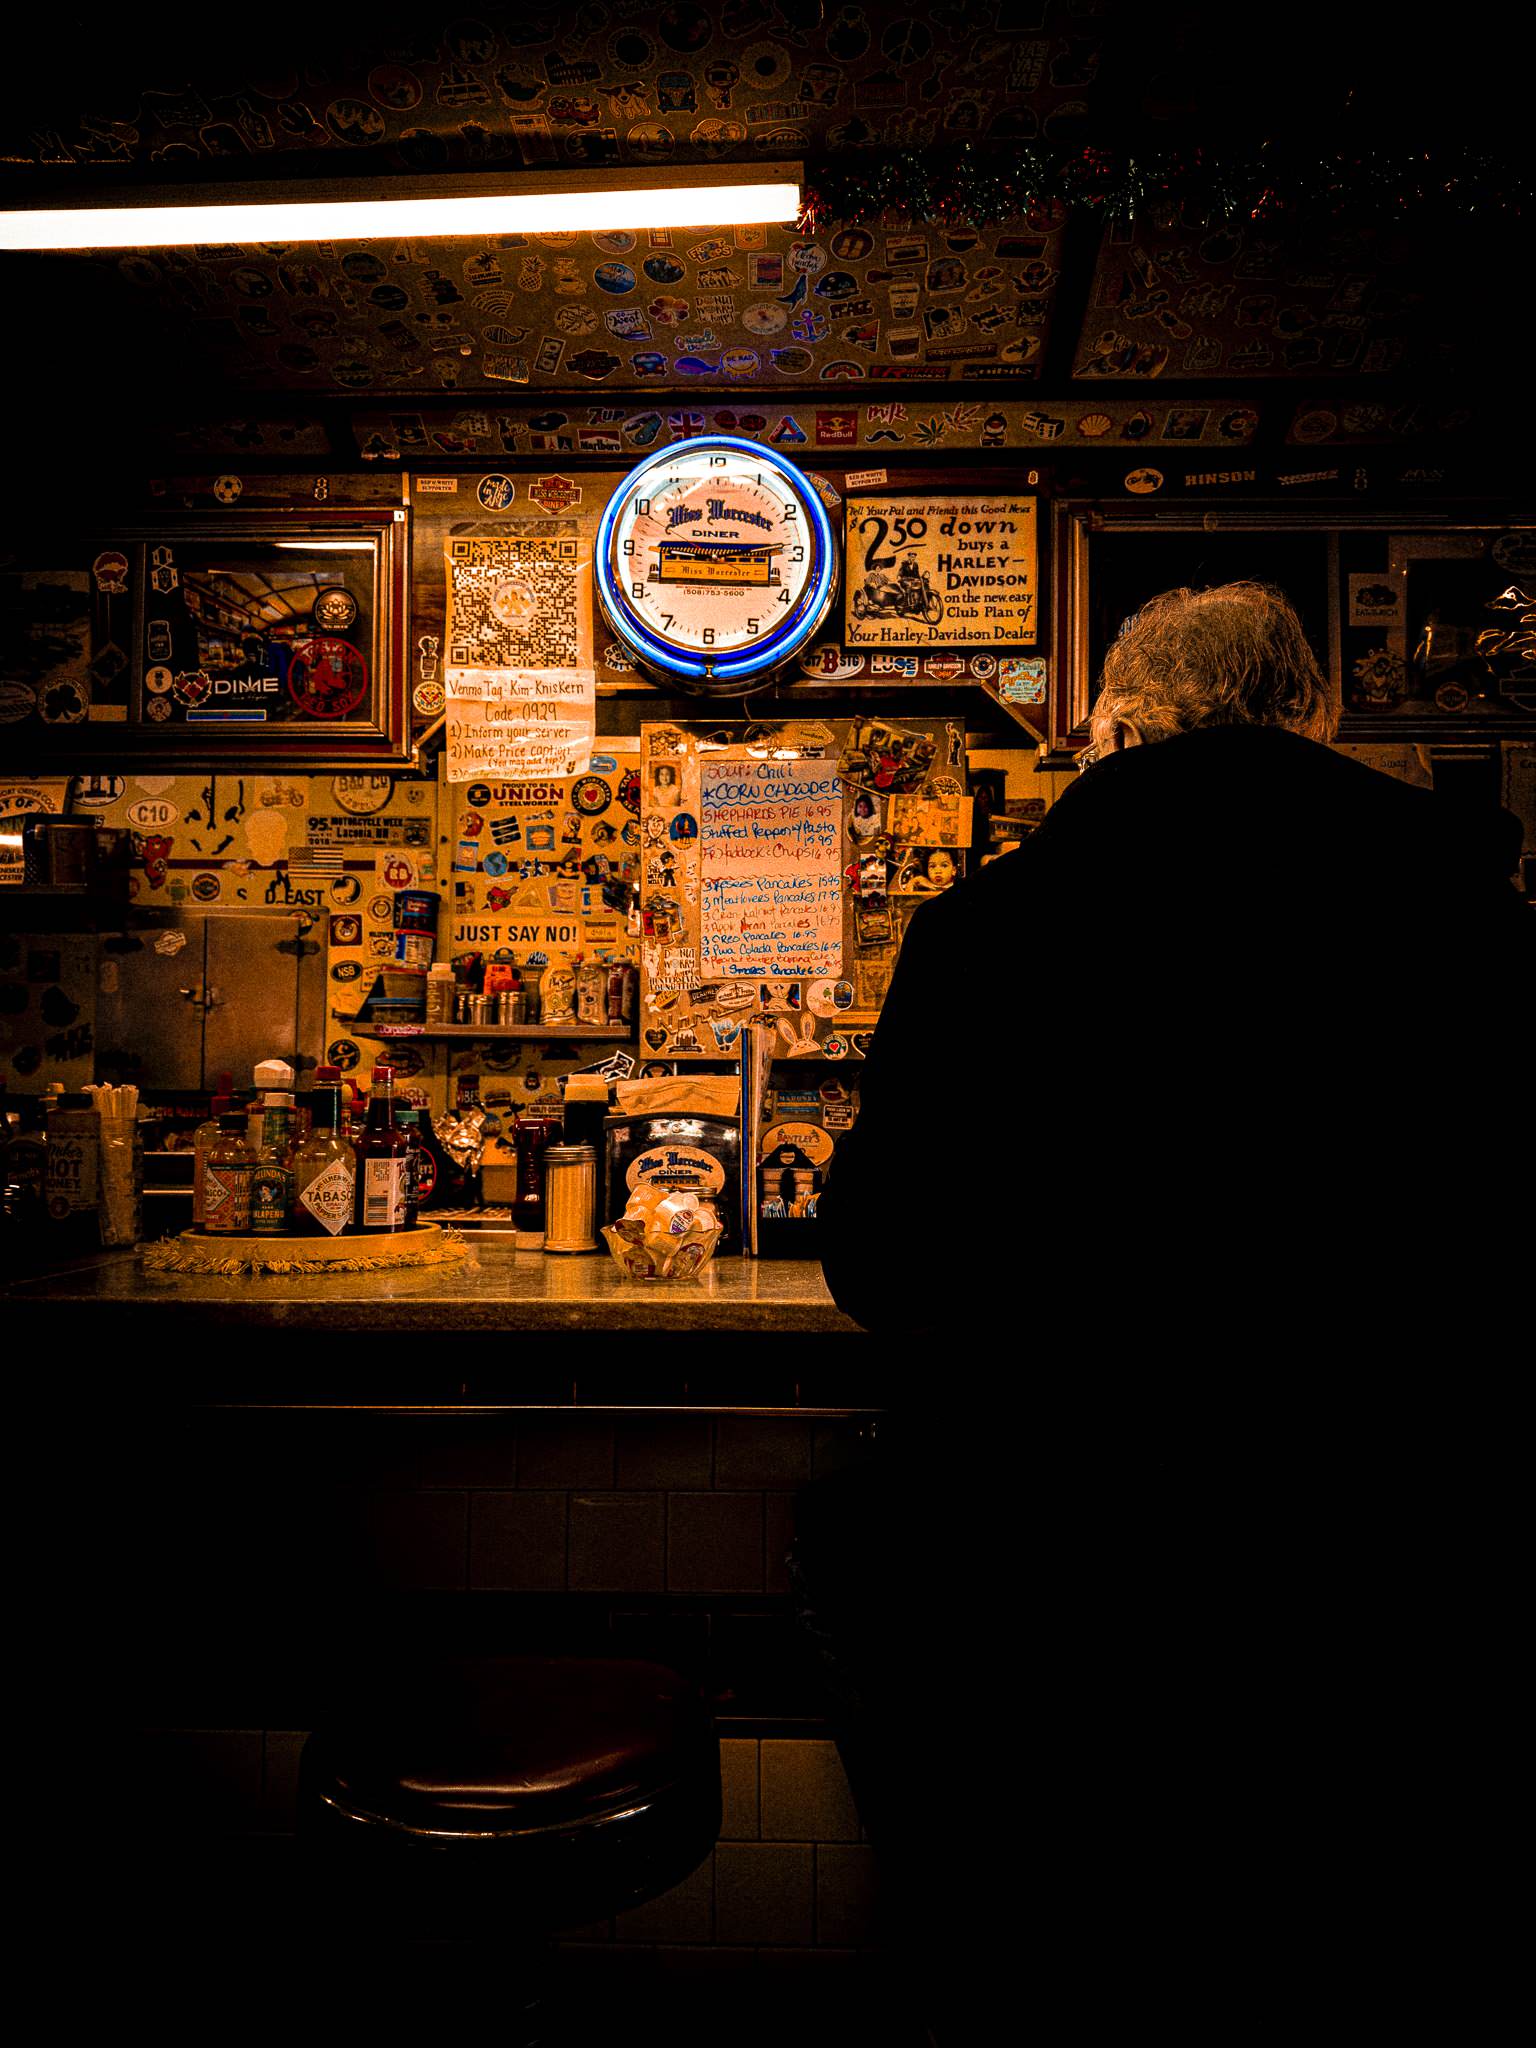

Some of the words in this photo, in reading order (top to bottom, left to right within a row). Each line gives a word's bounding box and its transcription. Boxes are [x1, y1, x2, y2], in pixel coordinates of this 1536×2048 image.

[635, 499, 650, 515] 10
[784, 504, 797, 521] 2
[866, 506, 888, 516] Your
[889, 506, 904, 516] Pal
[907, 506, 924, 516] and
[927, 506, 958, 516] Friends
[961, 504, 978, 515] this
[981, 504, 1006, 514] Good
[1008, 504, 1031, 513] News
[692, 530, 740, 539] DINER
[940, 517, 1018, 536] down
[624, 540, 635, 555] 9
[792, 546, 804, 562] 3
[958, 539, 994, 553] buys
[1000, 541, 1009, 550] a
[947, 573, 1028, 590] DAVIDSON
[632, 583, 644, 598] 8
[779, 589, 791, 604] 4
[944, 595, 960, 603] on
[962, 590, 981, 603] the
[1009, 594, 1033, 604] easy
[947, 606, 979, 617] Club
[985, 606, 1013, 617] Plan
[1017, 605, 1032, 623] of
[660, 614, 673, 631] 7
[747, 618, 759, 634] 5
[703, 628, 715, 644] 6
[848, 623, 878, 644] Your
[880, 627, 990, 644] Harley-Davidson
[994, 626, 1036, 640] Dealer
[449, 680, 482, 695] Venmo
[522, 703, 557, 721] 0929
[464, 724, 503, 739] Inform
[507, 729, 530, 743] your
[464, 744, 494, 758] Make
[499, 744, 526, 757] Price
[757, 763, 793, 779] Chili
[494, 788, 564, 800] UNION
[15, 797, 34, 809] OF
[138, 806, 169, 822] C10
[780, 806, 800, 819] PIE
[455, 926, 501, 941] JUST
[508, 926, 540, 941] SAY
[546, 926, 577, 941] NO!
